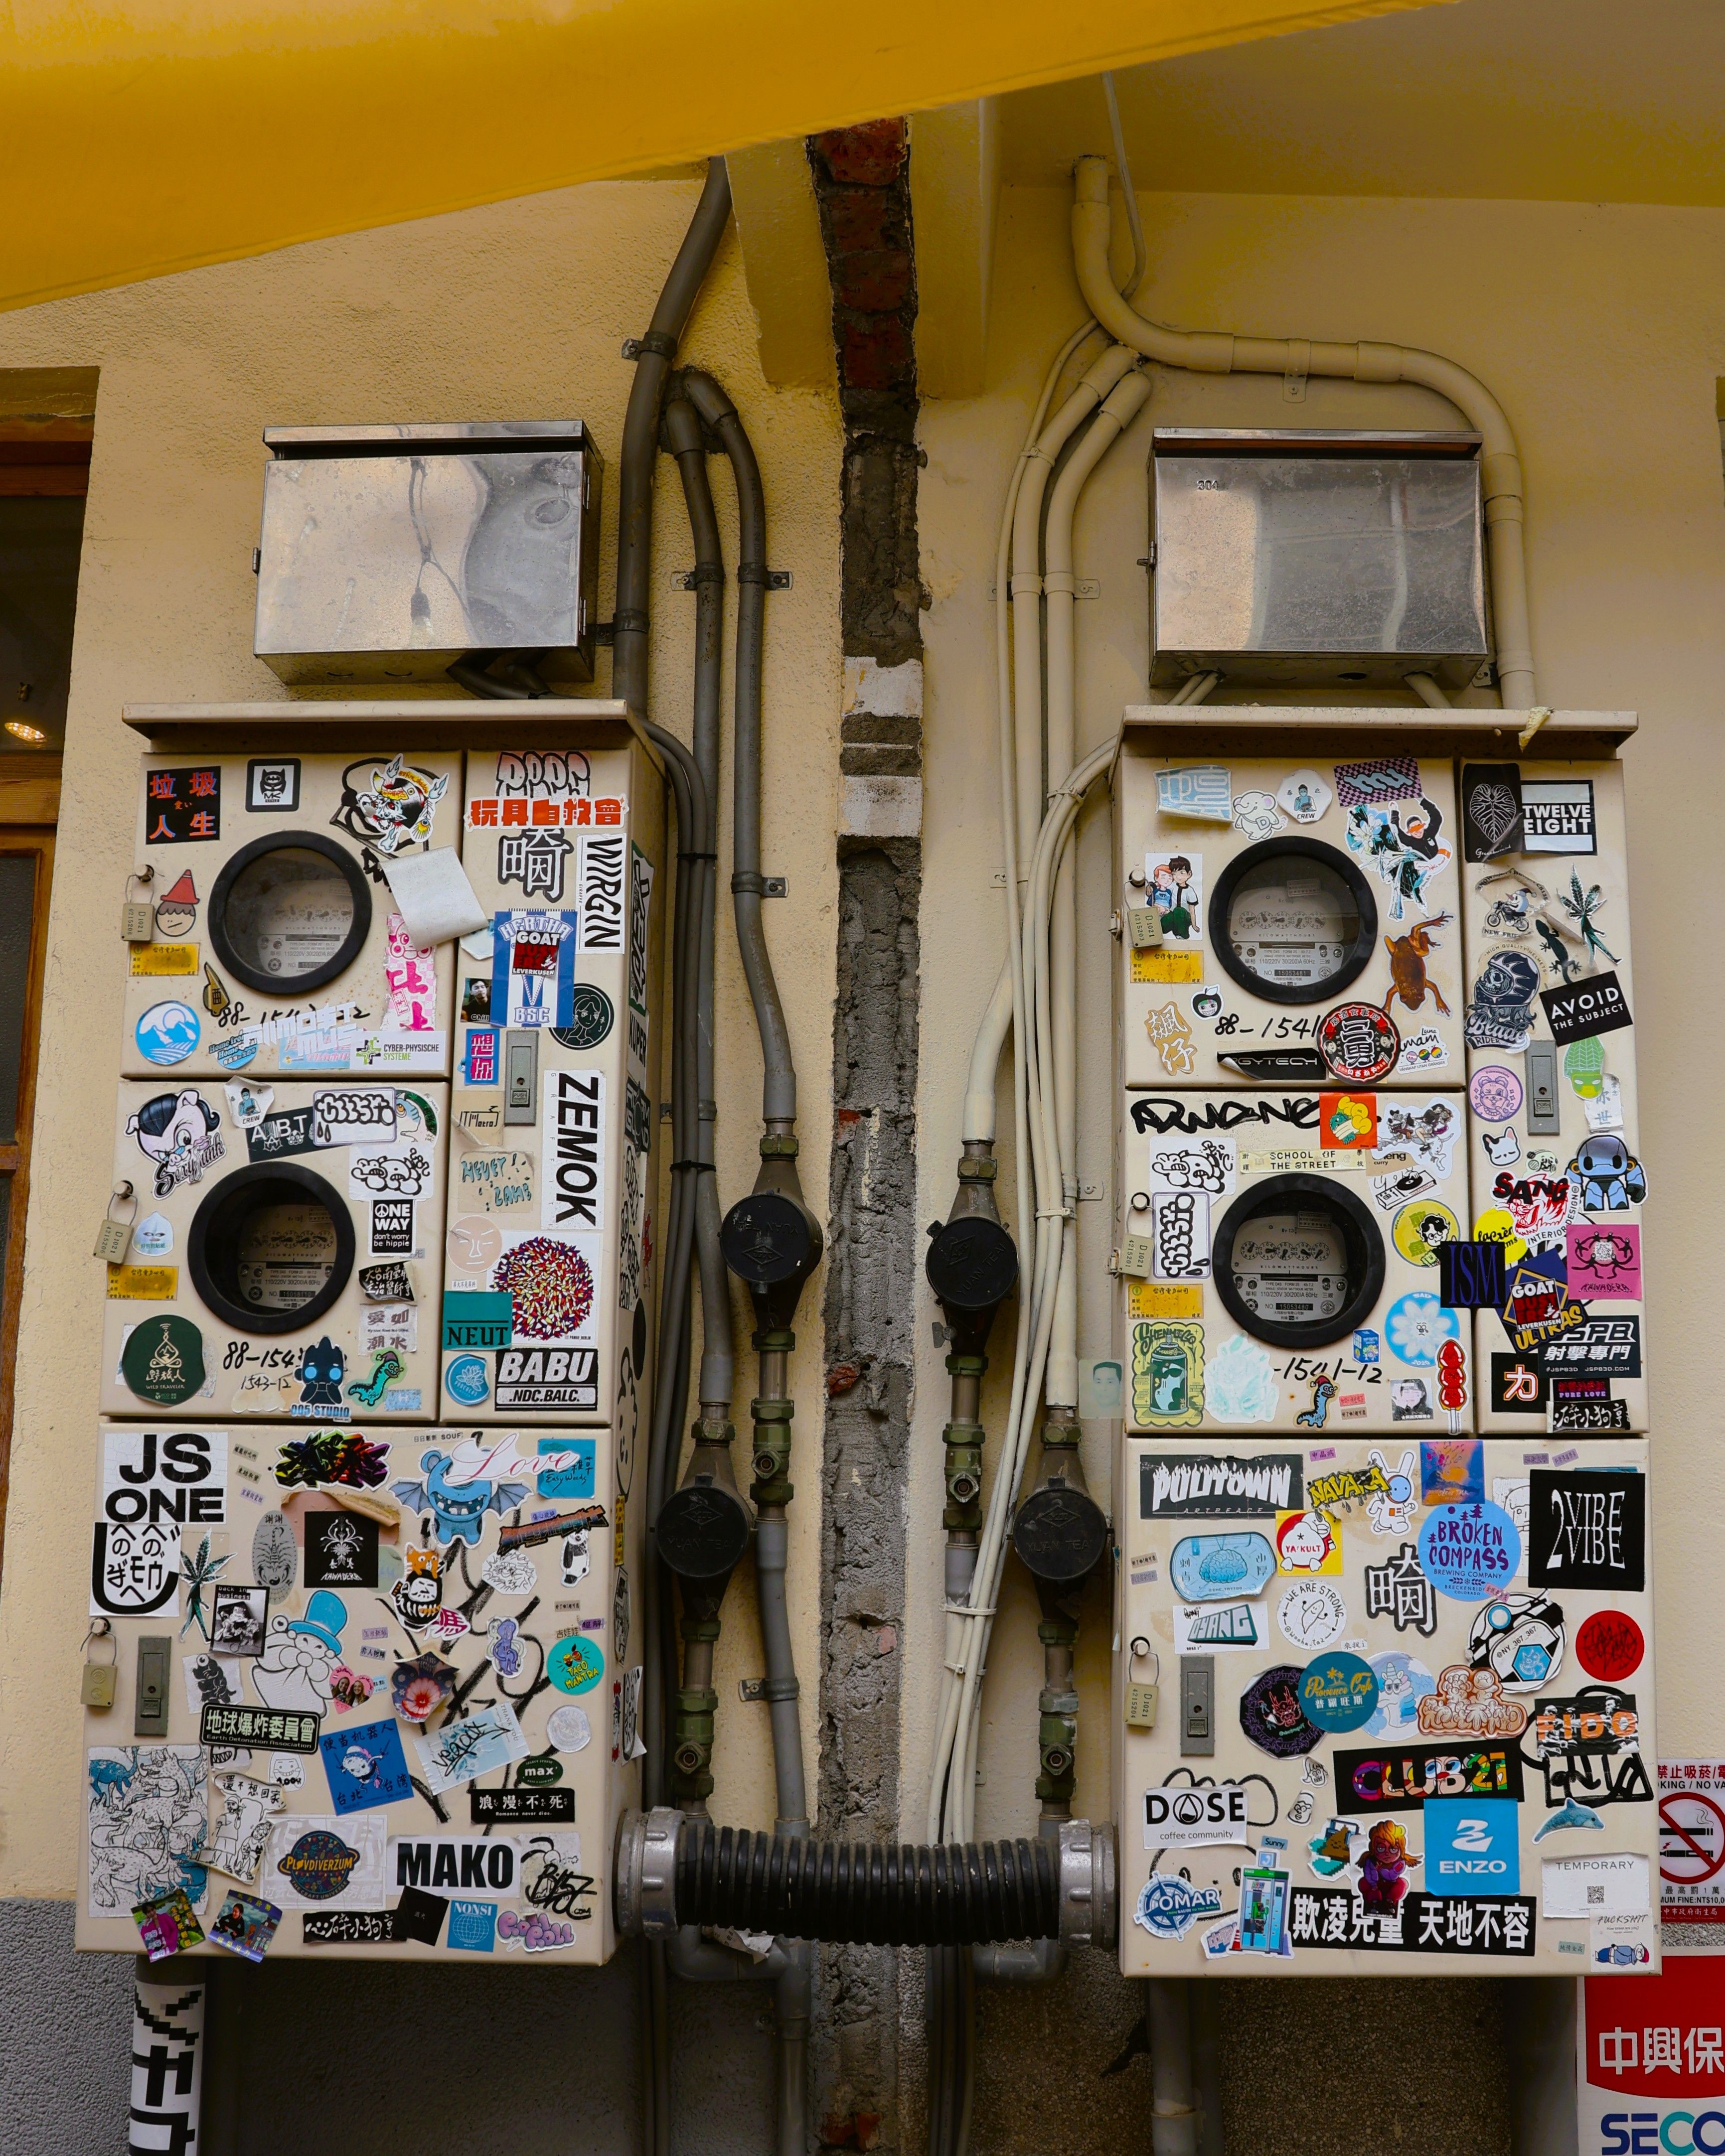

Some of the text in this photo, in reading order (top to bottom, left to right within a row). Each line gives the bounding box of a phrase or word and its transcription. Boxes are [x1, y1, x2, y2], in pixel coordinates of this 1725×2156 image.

[1197, 480, 1218, 490] 304
[150, 772, 217, 798] 垃圾
[1522, 805, 1590, 818] TWELVE
[150, 811, 216, 839] 人生
[1524, 819, 1591, 834] EIGHT
[498, 915, 573, 940] HERTHA
[1135, 914, 1144, 941] 4215203
[1145, 915, 1155, 937] D1021
[517, 931, 560, 945] GOAT
[1551, 987, 1620, 1019] AVOID
[514, 1007, 550, 1023] BSC
[1554, 1004, 1624, 1030] THE SUBJECT
[383, 1043, 439, 1052] CYBER-PHYSISCHE
[243, 1116, 260, 1124] CREW
[556, 1073, 598, 1226] ZEMOK
[375, 1218, 410, 1230] WAY
[1528, 1226, 1567, 1245] INTERIOR
[1137, 1245, 1147, 1268] D1021
[955, 1266, 984, 1296] YUAN
[1449, 1244, 1501, 1305] ISM
[1512, 1282, 1555, 1298] GOAT
[1518, 1319, 1562, 1330] LEVERKUSEN
[447, 1327, 507, 1345] NEUT
[1544, 1345, 1631, 1361] 射擊專門
[498, 1352, 594, 1383] BABU
[313, 1405, 349, 1417] STUDIO
[120, 1434, 211, 1483] JS
[445, 1433, 580, 1485] Love
[545, 1474, 564, 1492] Easy
[106, 1488, 224, 1522] ONE
[265, 1514, 283, 1524] 謝謝
[1438, 1520, 1503, 1546] BROKEN
[1429, 1545, 1509, 1571] COMPASS
[1287, 1582, 1344, 1618] WE ARE STRONG
[567, 1661, 588, 1676] TACO
[566, 1669, 599, 1690] MANTRA
[500, 1704, 513, 1726] THANK
[1142, 1693, 1152, 1718] D1021
[206, 1710, 315, 1742] 地球爆炸委員會
[1537, 1710, 1636, 1741] FIDO
[270, 1740, 312, 1748] Association
[525, 1766, 554, 1776] max
[1659, 1781, 1711, 1789] KING NO
[1160, 1830, 1234, 1840] coffee community
[1265, 1838, 1285, 1849] Sunny
[397, 1843, 513, 1889] MAKO
[1439, 1860, 1507, 1874] ENZO
[1556, 1861, 1634, 1870] TEMPORARY
[1159, 1889, 1218, 1911] OMAR
[1418, 1900, 1529, 1949] 天地不容
[1597, 1914, 1649, 1925] FUCKSHIT
[1600, 2111, 1725, 2156] SECO
